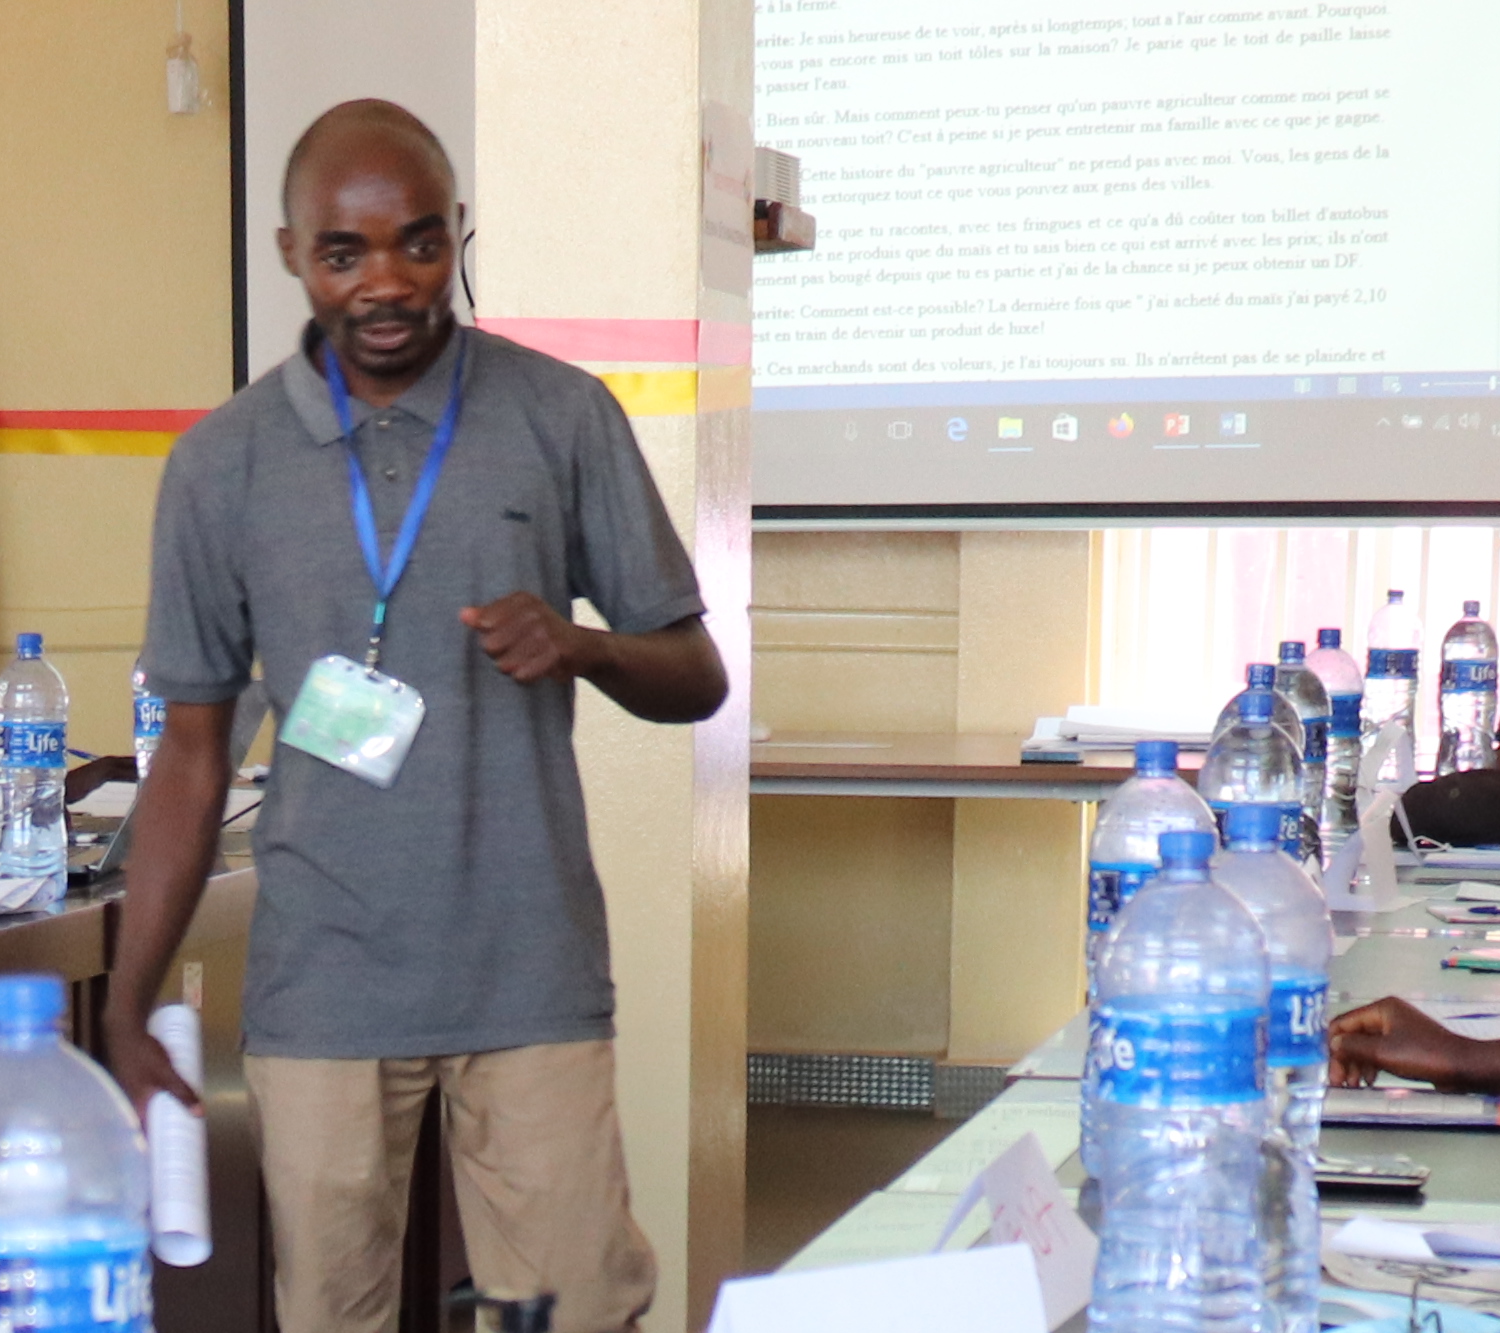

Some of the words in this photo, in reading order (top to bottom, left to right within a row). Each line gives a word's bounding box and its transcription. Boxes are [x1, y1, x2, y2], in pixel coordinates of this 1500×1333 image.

[796, 0, 840, 12] ferme.
[817, 34, 845, 44] suis
[848, 30, 911, 43] heureuse
[952, 26, 985, 37] voir,
[988, 24, 1028, 38] après
[1132, 15, 1161, 27] tout
[1208, 11, 1263, 23] comme
[1266, 8, 1312, 20] avant.
[1316, 5, 1390, 19] Pourquoi.
[828, 55, 876, 66] encore
[882, 53, 908, 64] mis
[938, 49, 963, 61] toit
[968, 46, 1003, 59] tôles
[1056, 39, 1119, 55] maison?
[1146, 39, 1184, 54] parie
[1243, 33, 1269, 45] toit
[1299, 29, 1342, 46] paille
[1348, 28, 1391, 40] laisse
[765, 81, 810, 96] passer
[766, 113, 800, 127] Bien
[804, 111, 828, 125] sûr.
[834, 110, 870, 123] Mais
[874, 108, 940, 121] comment
[944, 106, 1000, 121] peux-tu
[1004, 104, 1052, 119] penser
[1101, 99, 1152, 114] pauvre
[1156, 94, 1237, 111] agriculteur
[1240, 93, 1297, 104] comme
[1301, 91, 1331, 102] moi
[1336, 88, 1369, 104] peut
[796, 136, 857, 148] nouveau
[860, 131, 894, 145] toit?
[948, 130, 987, 144] peine
[1025, 127, 1061, 141] peux
[1065, 123, 1136, 135] entretenir
[1167, 118, 1220, 131] famille
[1224, 118, 1258, 129] avec
[1334, 113, 1383, 128] gagne.
[801, 168, 837, 181] Cette
[840, 167, 893, 180] histoire
[1089, 155, 1132, 173] prend
[1164, 156, 1198, 167] avec
[1202, 155, 1234, 165] moi.
[1241, 150, 1284, 163] Vous,
[1313, 150, 1349, 164] gens
[821, 191, 891, 205] extorquez
[894, 189, 923, 200] tout
[977, 187, 1012, 197] vous
[1015, 184, 1069, 199] pouvez
[1103, 182, 1137, 196] gens
[1170, 176, 1214, 190] villes.
[888, 224, 952, 236] racontes,
[958, 223, 990, 233] avec
[1022, 219, 1082, 233] fringues
[1188, 213, 1236, 225] coûter
[1271, 210, 1311, 222] billet
[847, 247, 901, 263] produis
[957, 246, 992, 256] maïs
[1032, 244, 1060, 254] sais
[1064, 240, 1096, 253] bien
[1174, 235, 1218, 249] arrivé
[1222, 237, 1256, 248] avec
[1327, 231, 1346, 245] ils
[828, 270, 872, 286] bougé
[875, 269, 922, 285] depuis
[994, 267, 1035, 281] partie
[1121, 261, 1173, 274] chance
[1212, 261, 1248, 274] peux
[1252, 257, 1306, 270] obtenir
[1334, 253, 1361, 268] DF.
[799, 305, 869, 318] Comment
[872, 305, 914, 316] est-ce
[917, 299, 985, 316] possible?
[1010, 299, 1070, 312] dernière
[1074, 296, 1102, 310] fois
[1173, 293, 1221, 307] acheté
[1246, 295, 1283, 305] maïs
[1313, 289, 1350, 305] payé
[1353, 288, 1387, 304] 2,10
[794, 330, 827, 341] train
[852, 326, 905, 339] devenir
[930, 323, 983, 340] produit
[1008, 321, 1045, 335] luxe!
[766, 361, 794, 375] Ces
[797, 360, 874, 375] marchands
[878, 362, 907, 372] sont
[940, 357, 997, 371] voleurs,
[1045, 358, 1105, 371] toujours
[1135, 352, 1154, 366] Ils
[1304, 348, 1367, 365] plaindre
[28, 731, 60, 754] Life
